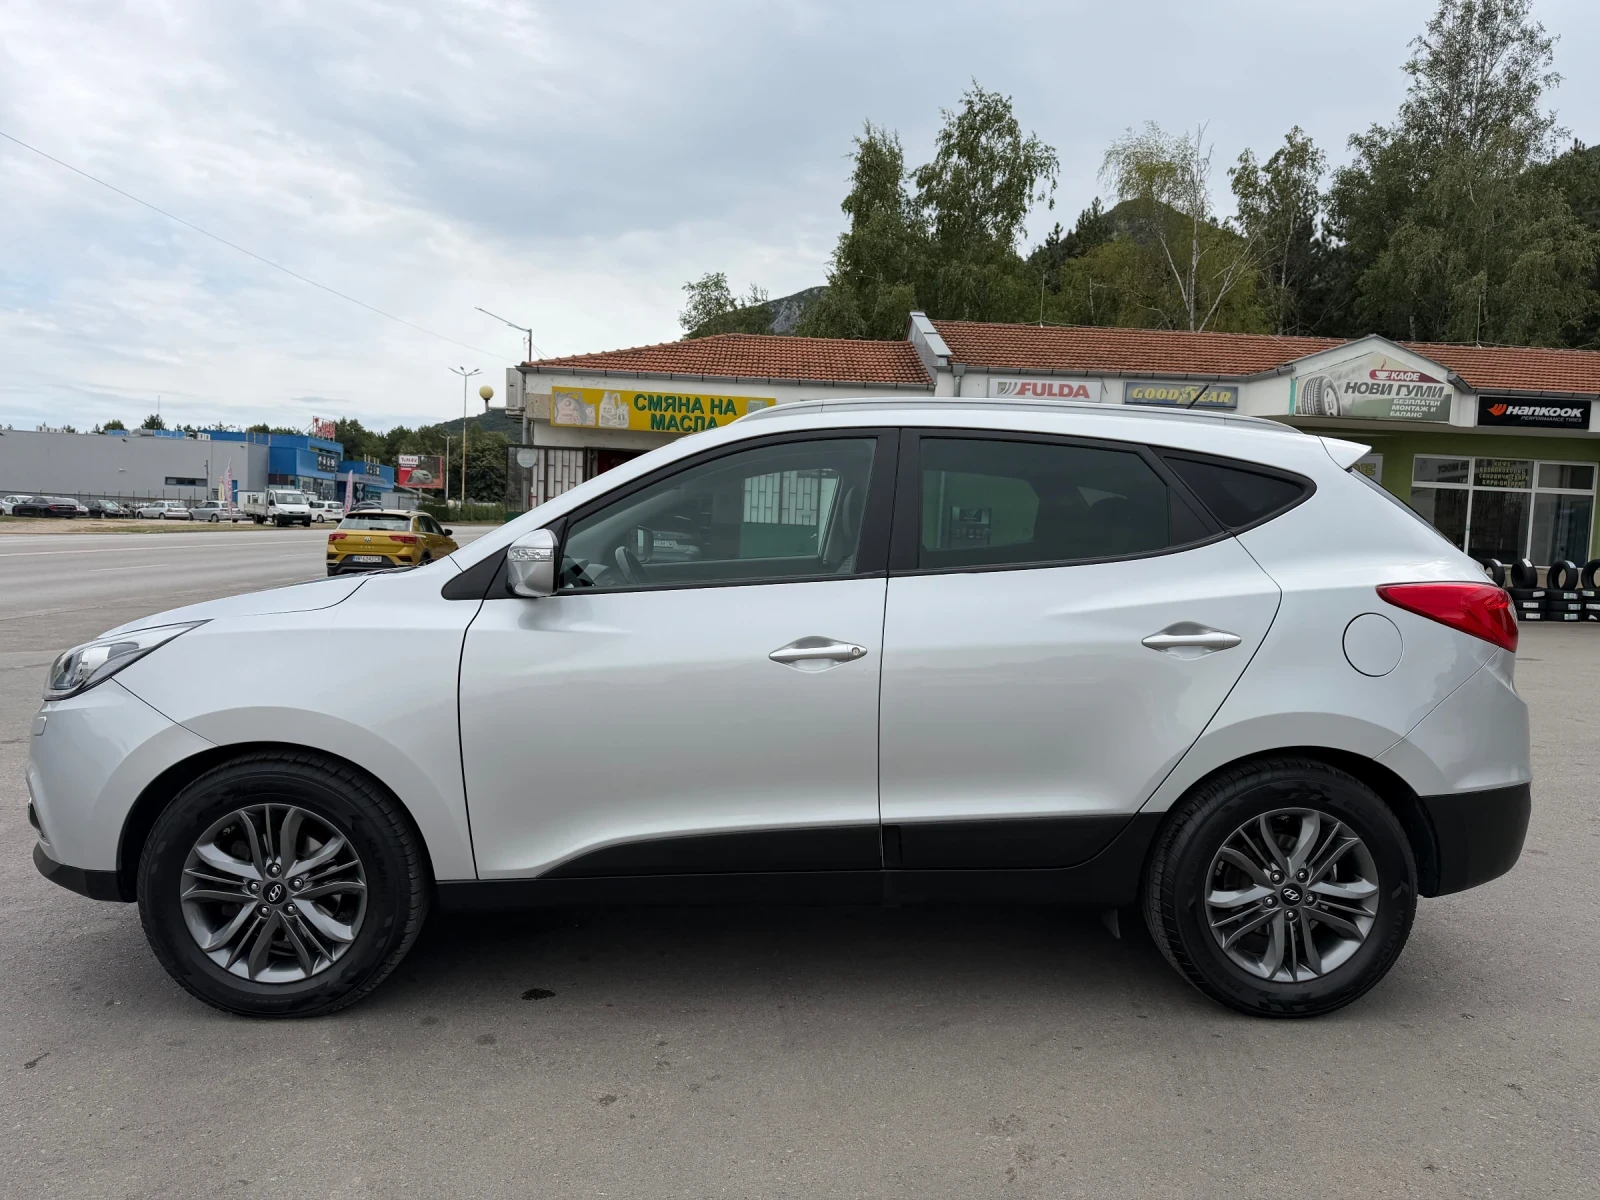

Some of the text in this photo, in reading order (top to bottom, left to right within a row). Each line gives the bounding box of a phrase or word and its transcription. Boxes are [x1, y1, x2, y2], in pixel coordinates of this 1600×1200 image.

[1391, 371, 1420, 381] КАФЕ
[1014, 382, 1091, 399] FULDA
[1344, 381, 1445, 399] НОВИ ГУМИ
[633, 393, 705, 415] СМЯНА
[710, 397, 737, 416] НА
[1391, 404, 1428, 412] МОНТАЖ
[1393, 398, 1440, 406] БЕЗПЛАТЕН
[1390, 410, 1422, 418] БАЛАНС
[651, 413, 719, 432] МАСЛА
